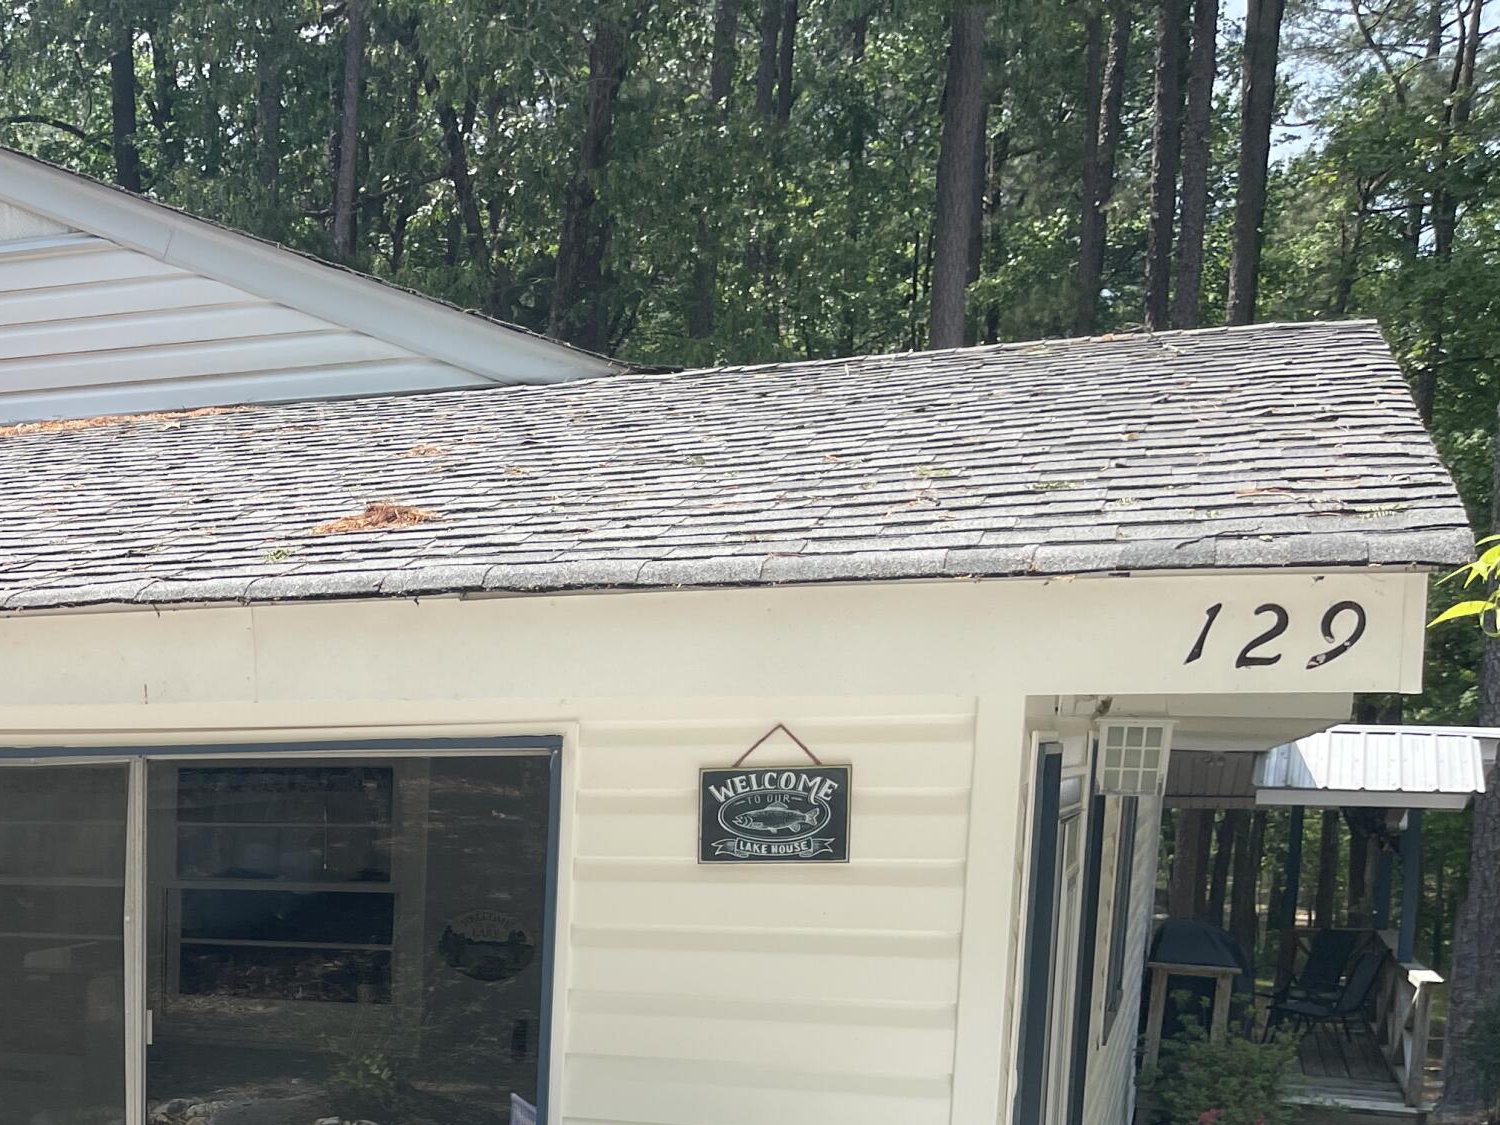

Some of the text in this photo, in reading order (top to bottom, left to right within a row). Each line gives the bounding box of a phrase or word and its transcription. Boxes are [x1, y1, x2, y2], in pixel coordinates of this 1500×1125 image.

[1183, 601, 1367, 670] 129
[708, 771, 839, 806] WELCOME
[746, 794, 791, 805] TO OUR
[739, 840, 809, 854] LAKE HOUSE
